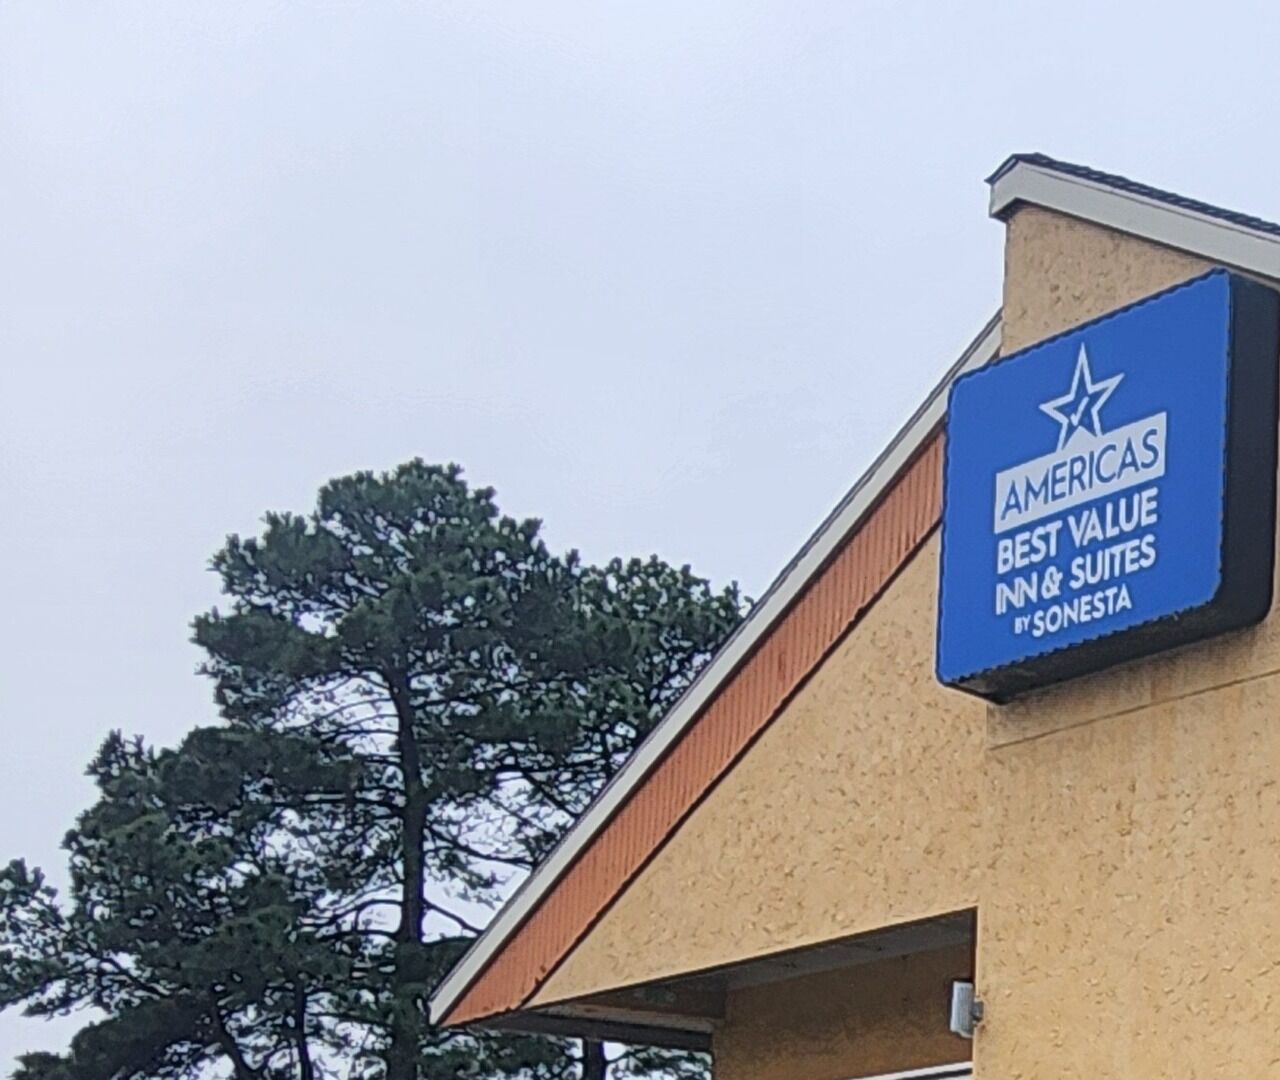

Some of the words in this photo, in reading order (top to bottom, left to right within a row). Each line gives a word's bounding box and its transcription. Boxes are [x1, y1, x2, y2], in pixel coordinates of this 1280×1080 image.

[1001, 428, 1160, 521] AMERICAS
[997, 521, 1062, 574] BEST
[1068, 488, 1158, 548] VALUE
[996, 572, 1038, 615] INN
[1041, 566, 1063, 600] &
[1069, 534, 1156, 588] SUITES
[1014, 616, 1032, 635] BY
[1032, 584, 1132, 637] SONESTA
